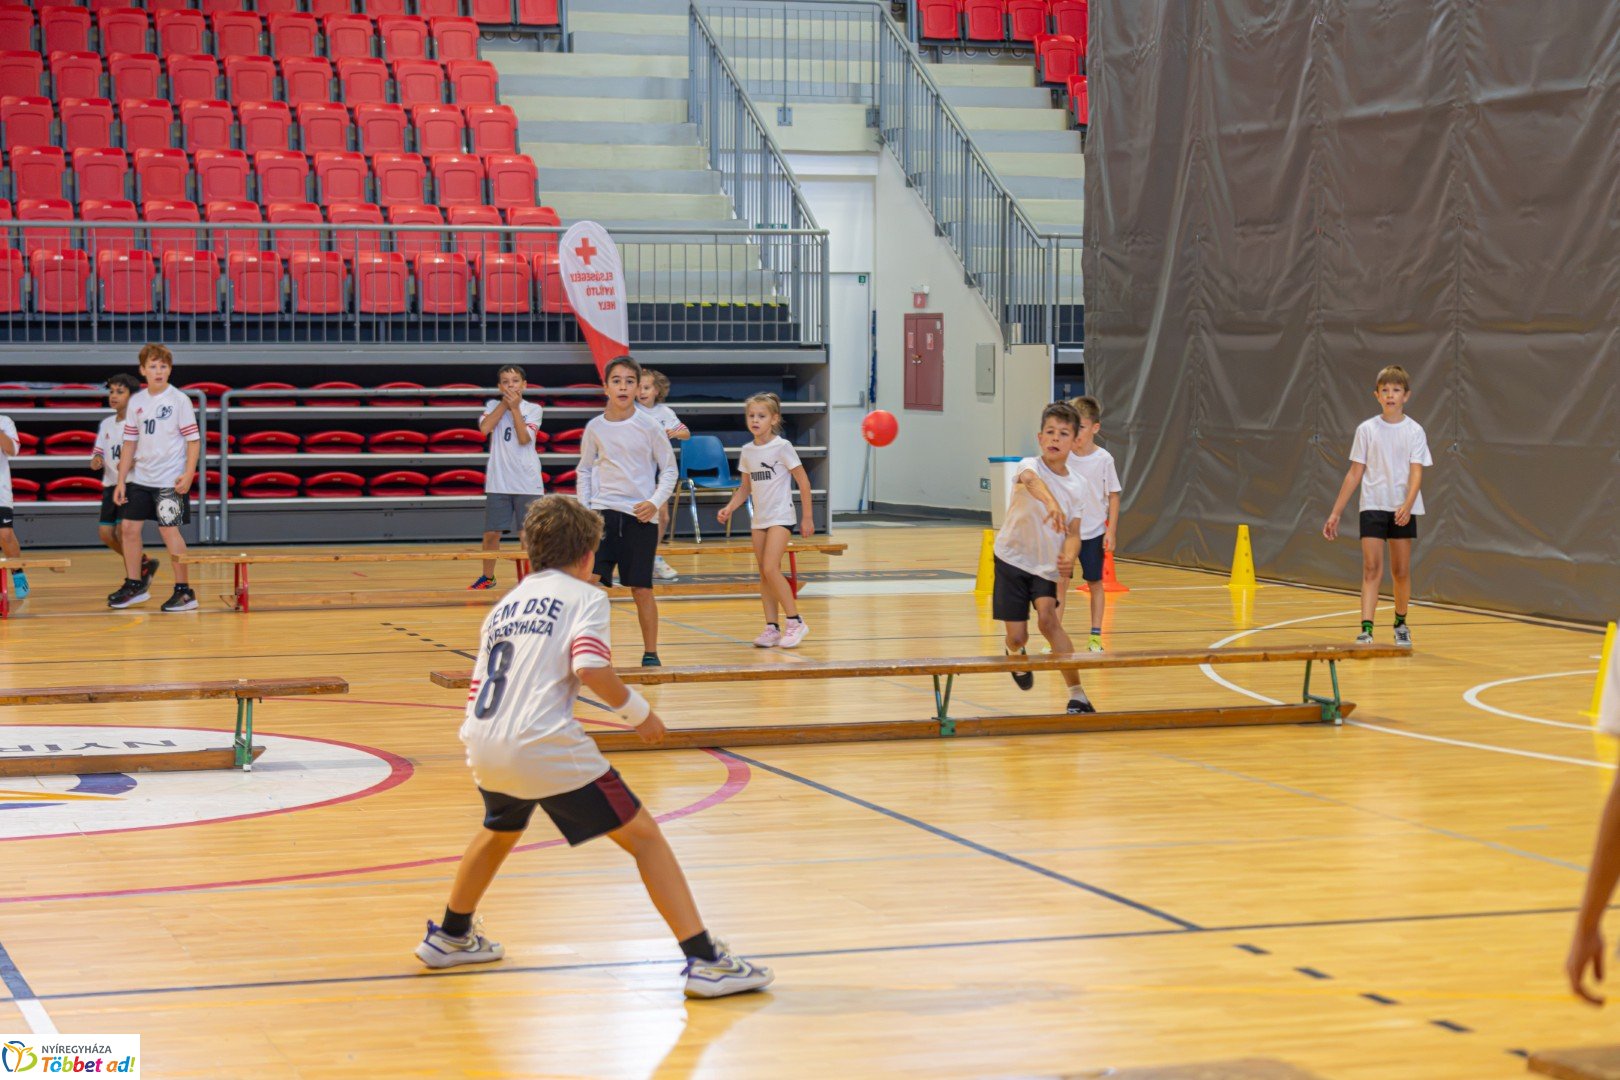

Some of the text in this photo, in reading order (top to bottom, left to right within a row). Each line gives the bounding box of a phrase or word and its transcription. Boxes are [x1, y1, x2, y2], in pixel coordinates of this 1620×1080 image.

[144, 419, 155, 435] 10
[504, 427, 512, 442] 6
[111, 444, 121, 460] 14
[751, 471, 771, 481] PUMA
[488, 597, 564, 630] EM DSE
[475, 641, 514, 720] 8
